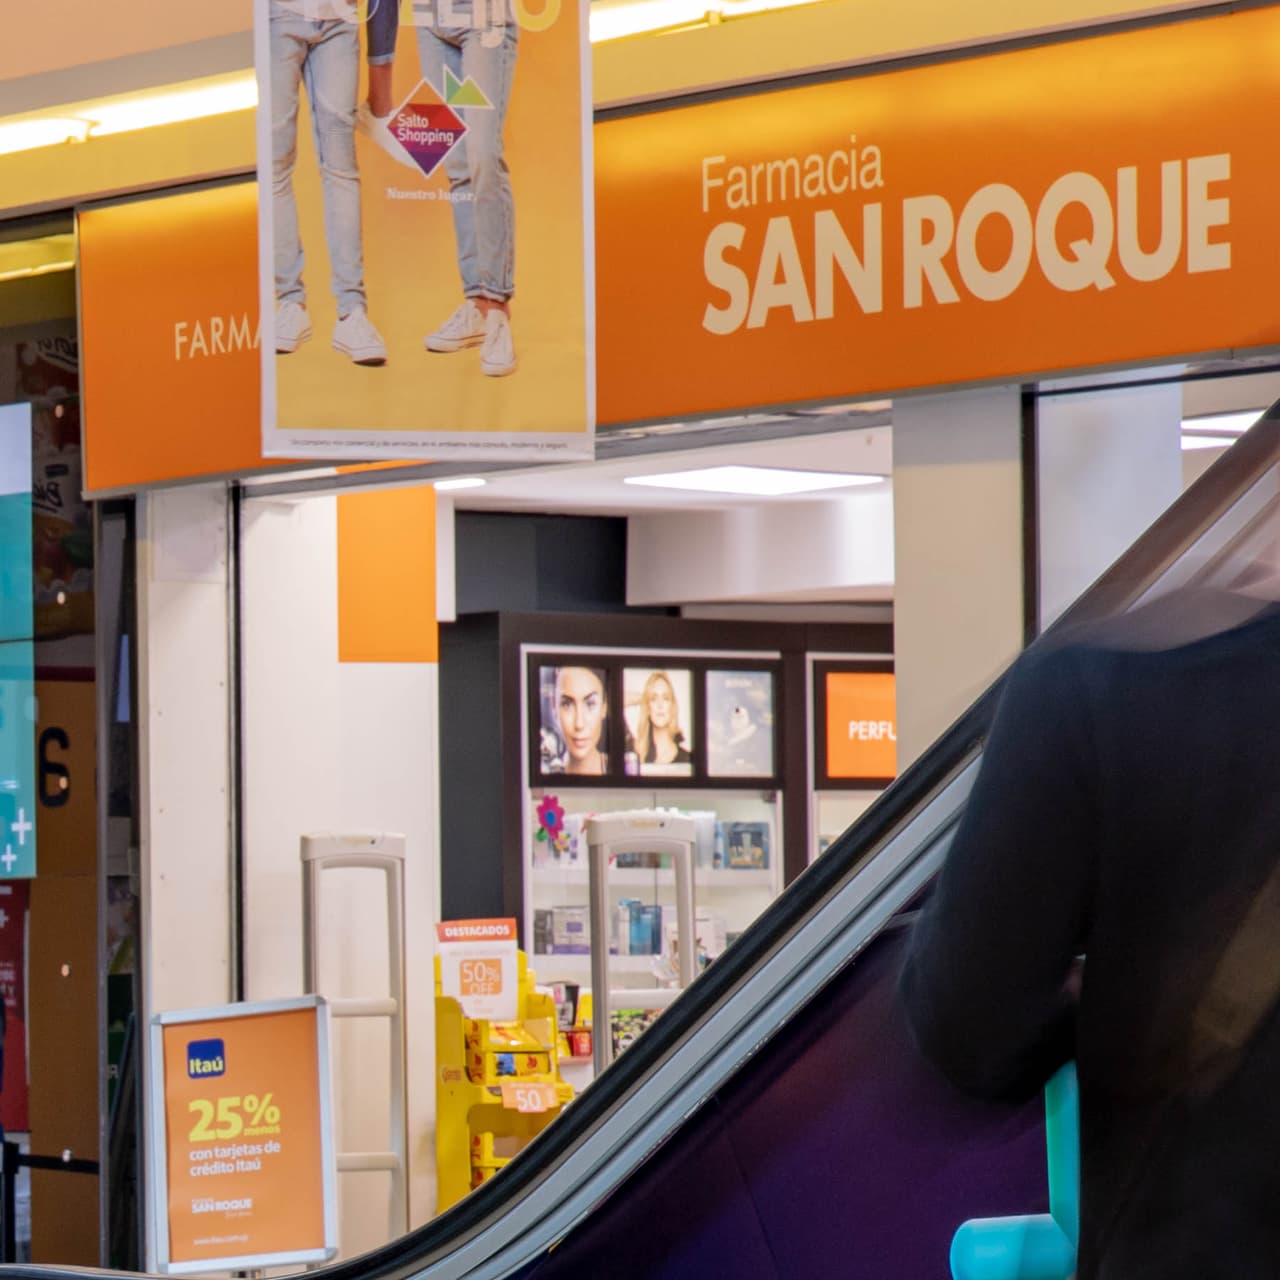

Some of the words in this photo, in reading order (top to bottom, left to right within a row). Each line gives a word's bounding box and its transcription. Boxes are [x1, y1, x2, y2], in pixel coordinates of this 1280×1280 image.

[397, 114, 429, 128] Salto
[397, 128, 454, 146] Shopping
[701, 133, 884, 213] Farmacia
[387, 187, 436, 200] Nuestro
[701, 202, 884, 336] SAN
[902, 152, 1232, 309] ROQUE
[444, 924, 510, 938] DESTACADOS
[462, 961, 500, 983] 50%
[189, 1055, 225, 1075] Itaú
[188, 1093, 281, 1142] 25%
[189, 1149, 212, 1161] con
[214, 1143, 263, 1160] tarjetas
[264, 1139, 281, 1153] de
[189, 1161, 235, 1177] crédito
